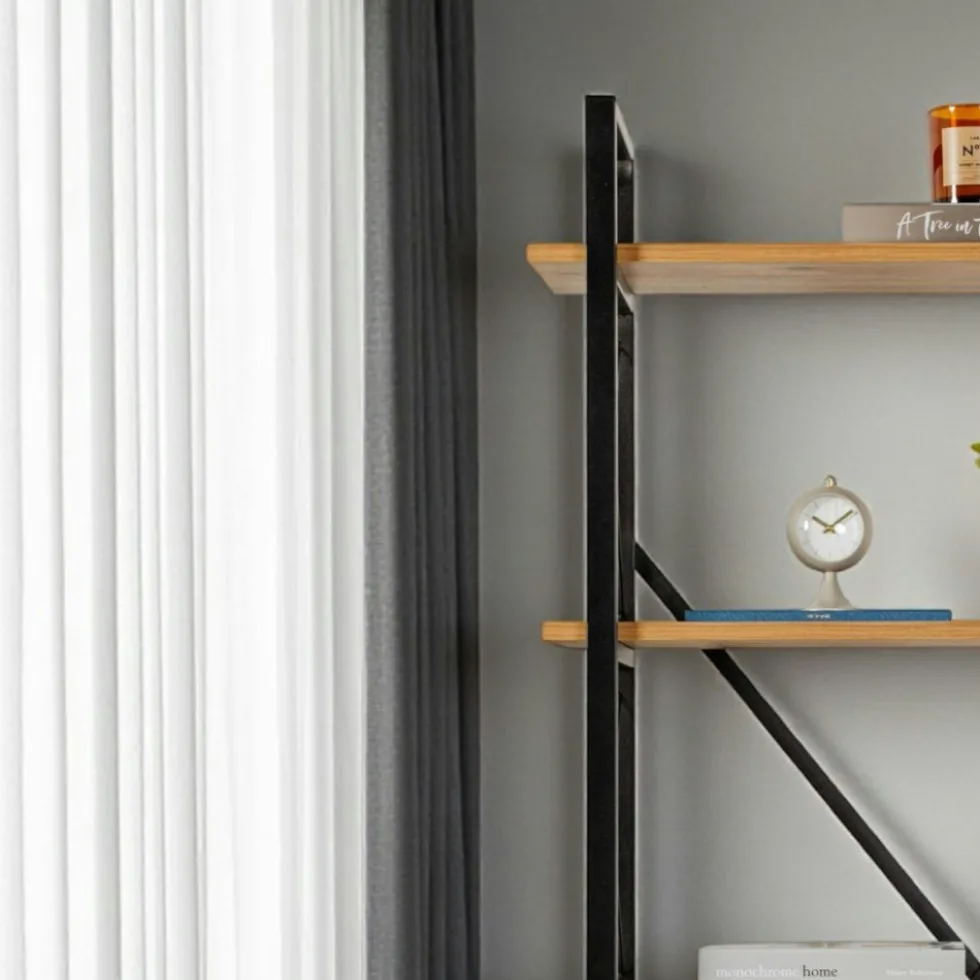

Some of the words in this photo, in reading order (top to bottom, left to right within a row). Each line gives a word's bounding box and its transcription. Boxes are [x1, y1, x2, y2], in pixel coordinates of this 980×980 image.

[896, 211, 913, 241] A
[912, 210, 953, 241] Tree
[955, 221, 974, 236] in
[716, 964, 799, 979] monochrome
[802, 964, 838, 978] home
